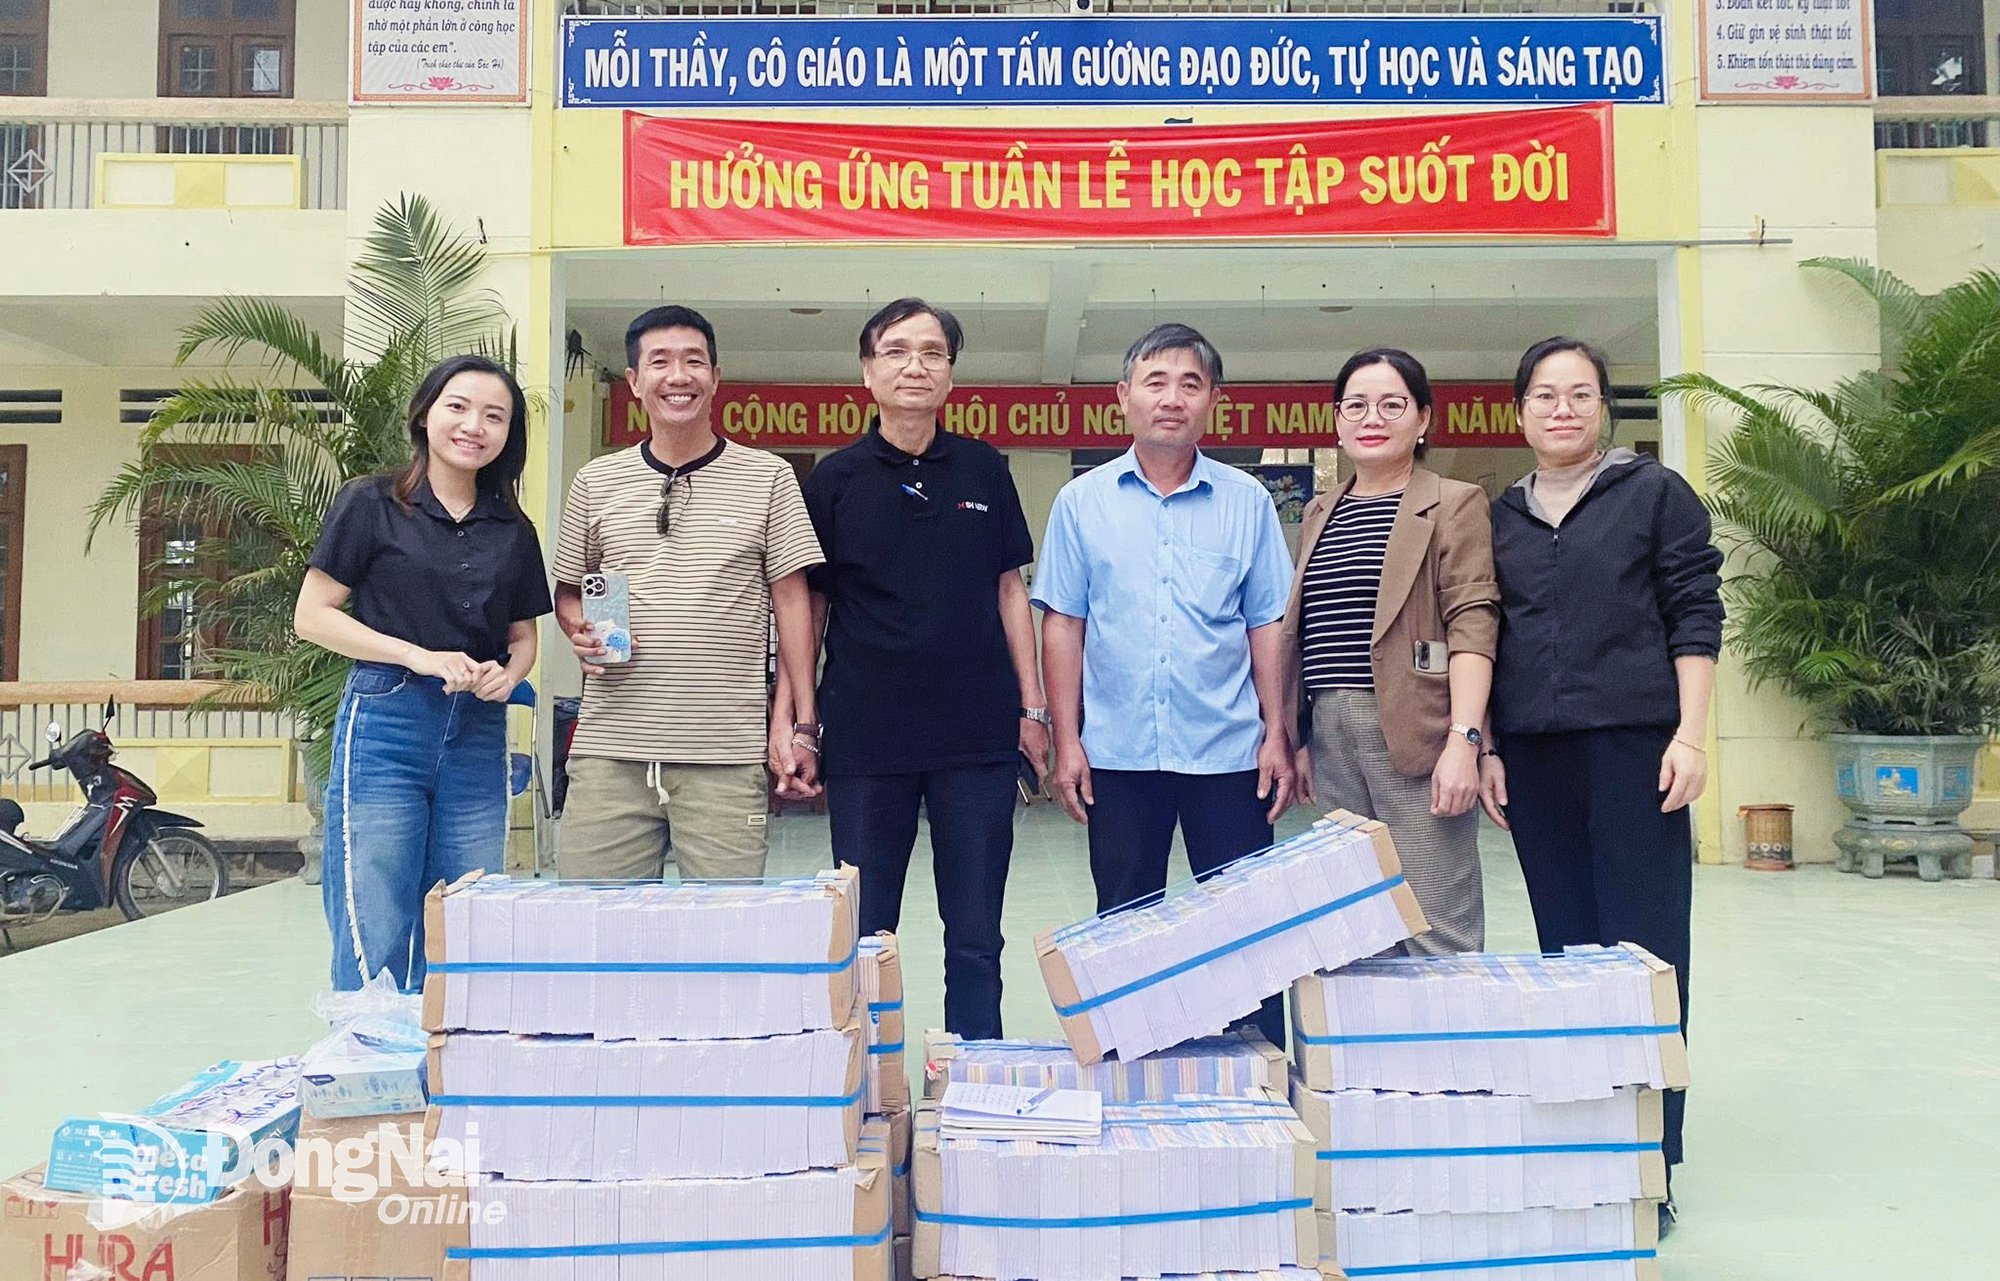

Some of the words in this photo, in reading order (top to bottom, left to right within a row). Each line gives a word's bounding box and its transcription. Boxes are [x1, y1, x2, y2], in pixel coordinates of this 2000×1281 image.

[368, 18, 388, 31] nhờ
[390, 20, 410, 34] một
[412, 16, 438, 34] phần
[442, 19, 457, 31] lớn
[460, 18, 467, 31] ở
[469, 20, 493, 35] công
[496, 20, 515, 35] học
[1716, 24, 1725, 39] 4.
[1727, 23, 1745, 40] Giữ
[1749, 24, 1765, 44] gìn
[1769, 24, 1780, 43] vệ
[1785, 24, 1806, 40] sinh
[1811, 24, 1832, 43] thật
[1837, 21, 1851, 40] tốt
[368, 41, 386, 56] tập
[389, 39, 408, 52] của
[411, 40, 429, 53] các
[586, 30, 639, 87] MỖI
[650, 31, 736, 95] THẦY,
[748, 37, 786, 87] CÔ
[798, 37, 865, 87] GIÁO
[877, 37, 912, 86] LÀ
[925, 37, 987, 94] MỘT
[998, 32, 1061, 85] TẤM
[1073, 39, 1169, 86] GƯƠNG
[1180, 47, 1240, 93] ĐẠO
[1250, 36, 1319, 93] ĐỨC,
[1329, 39, 1370, 93] TỰ
[1380, 47, 1439, 93] HỌC
[1449, 37, 1487, 85] VÀ
[1498, 37, 1575, 85] SÁNG
[1584, 47, 1643, 93] TẠO
[671, 142, 822, 209] HƯỞNG
[839, 148, 928, 210] ỨNG
[943, 140, 1060, 209] TUẦN
[1079, 139, 1131, 208] LỄ
[1152, 157, 1242, 217] HỌC
[1256, 143, 1345, 215] TẬP
[1360, 136, 1474, 204] SUỐT
[1491, 140, 1568, 201] ĐỜI
[722, 394, 807, 440] CỘNG
[944, 394, 997, 439] HỘI
[1009, 392, 1069, 435] CHỦ
[1206, 394, 1255, 441] IỆT
[1267, 403, 1334, 434] NAM
